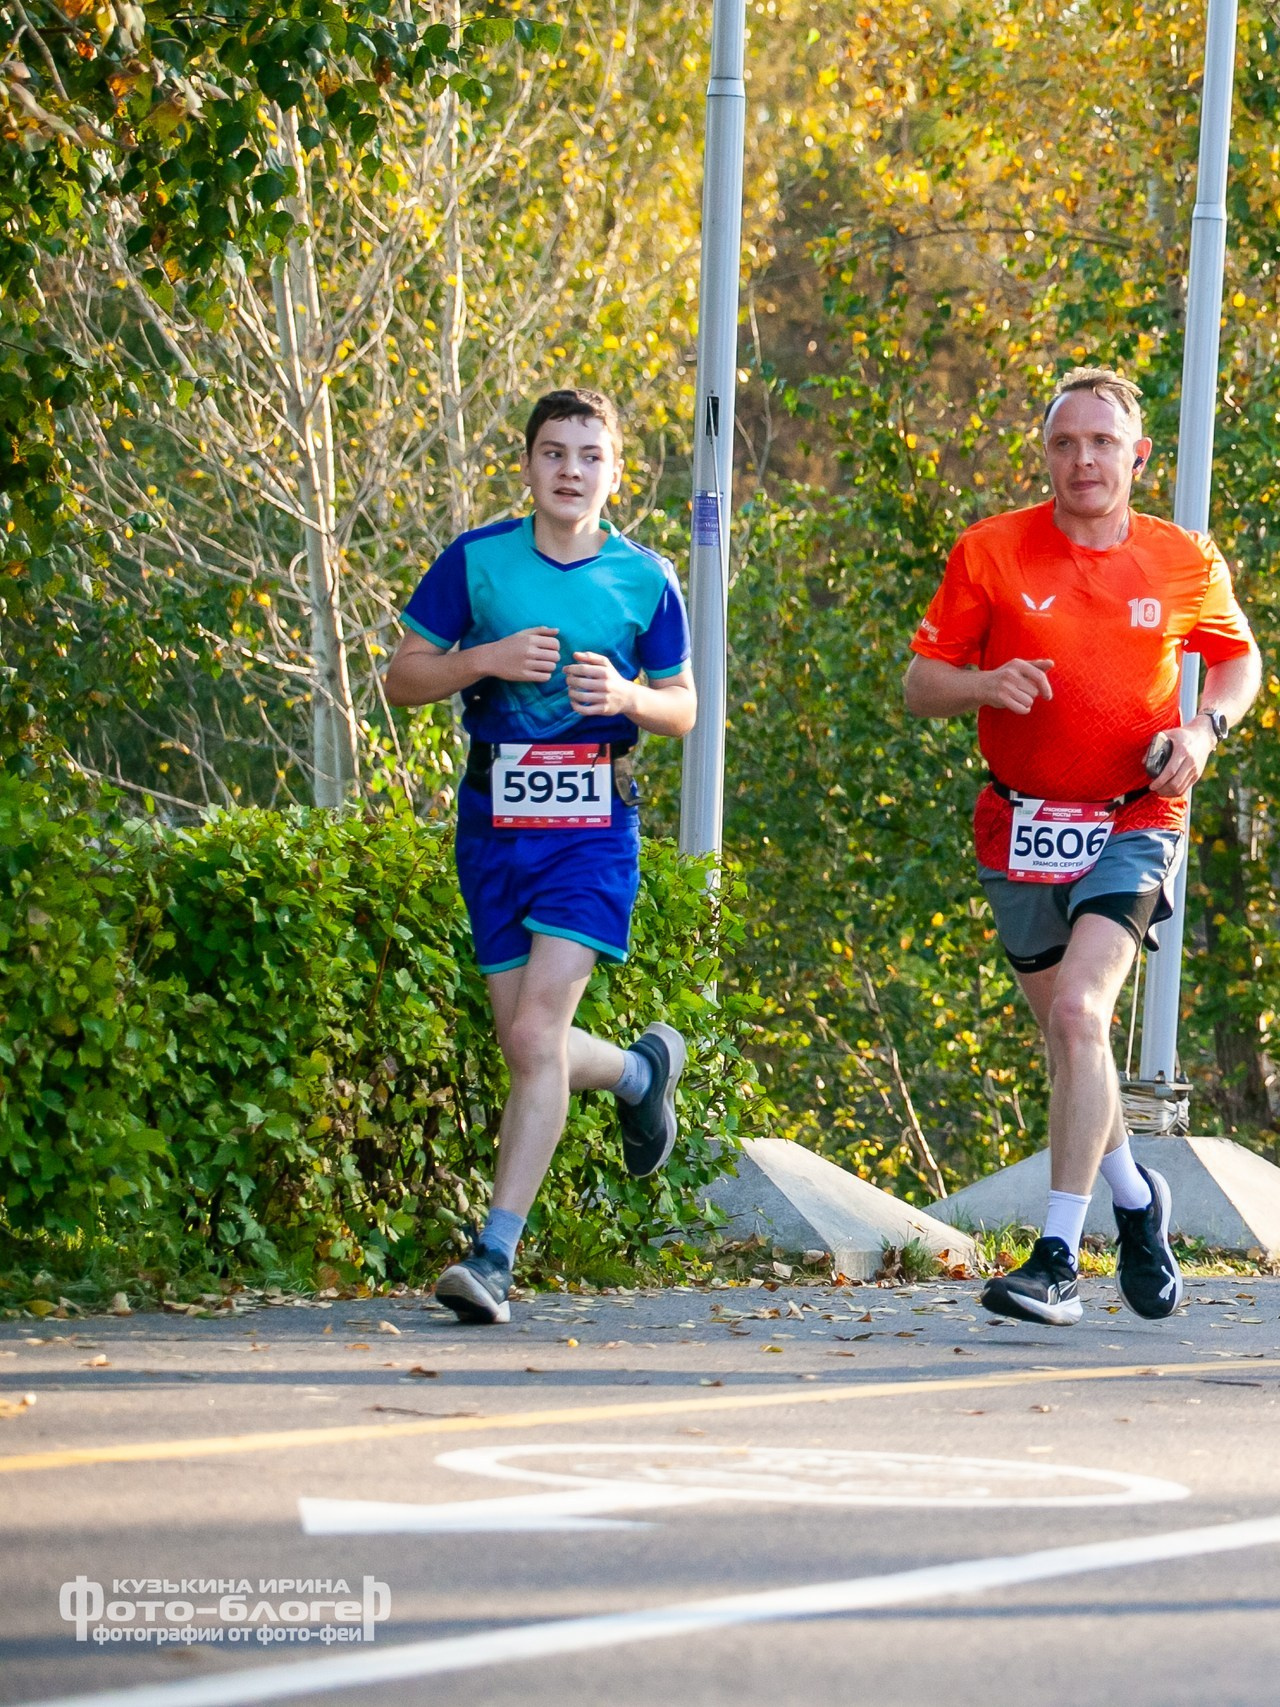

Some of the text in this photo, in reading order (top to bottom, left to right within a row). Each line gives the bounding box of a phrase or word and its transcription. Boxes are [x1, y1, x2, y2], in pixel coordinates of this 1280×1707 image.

[1127, 598, 1161, 628] 10
[504, 771, 600, 803] 5951
[1014, 825, 1107, 860] 5606
